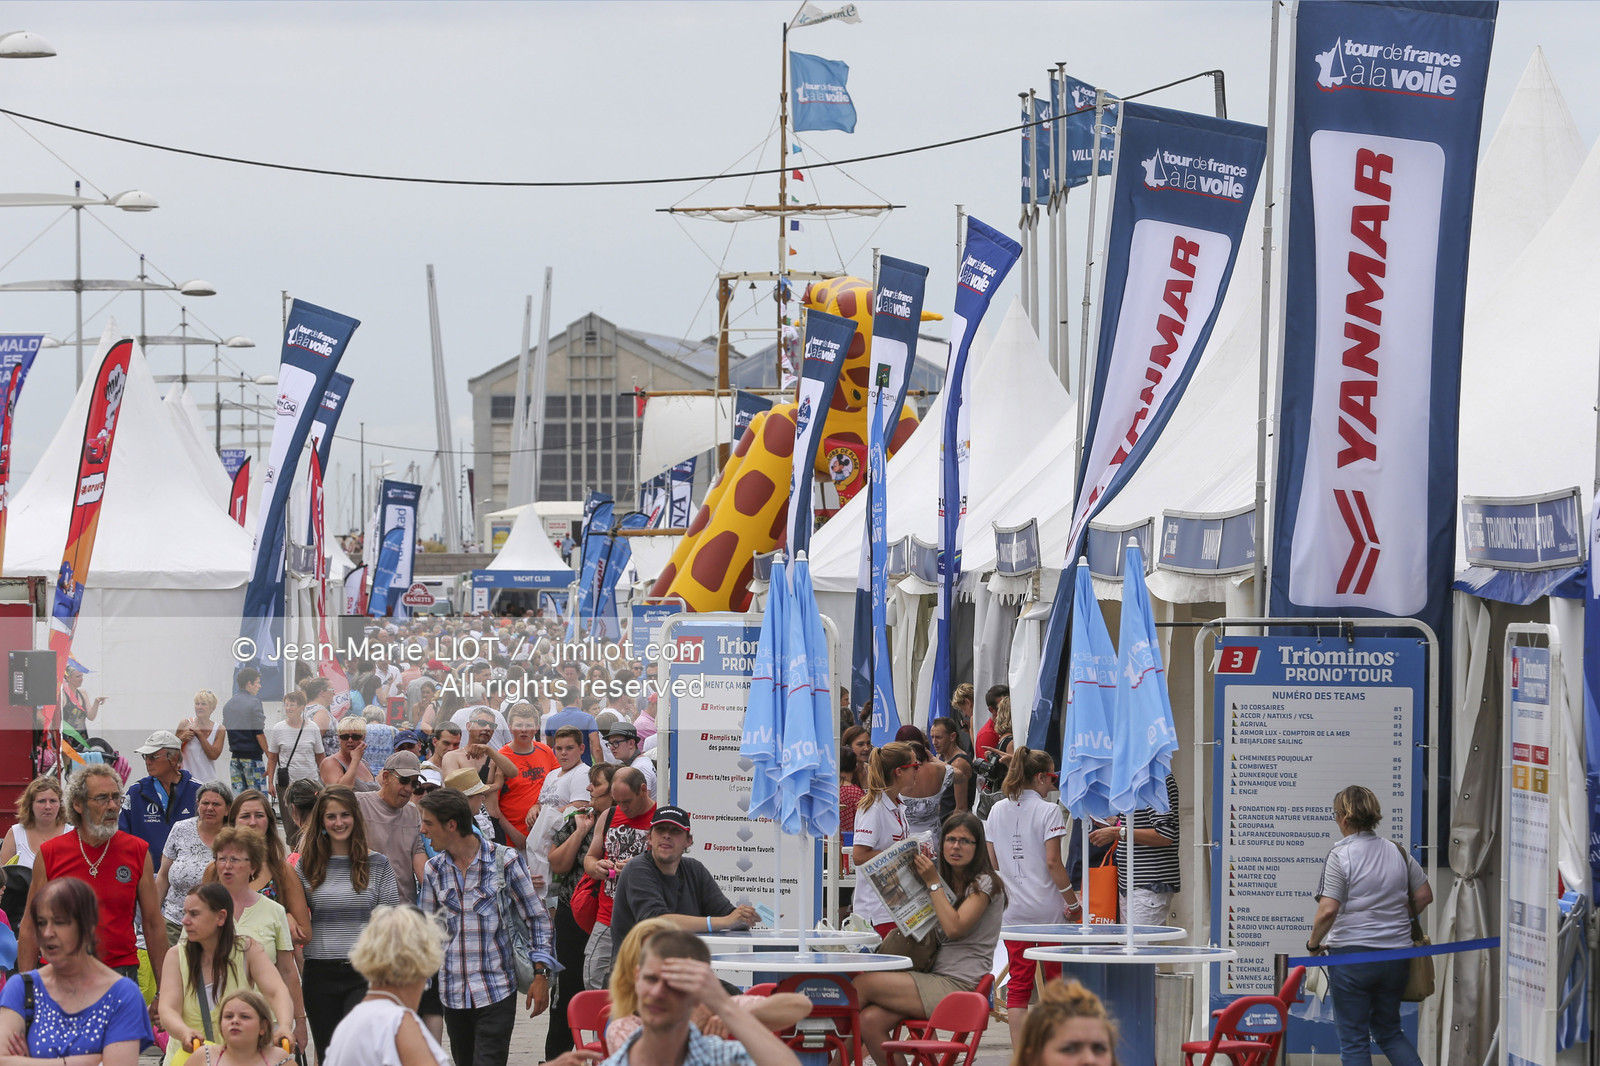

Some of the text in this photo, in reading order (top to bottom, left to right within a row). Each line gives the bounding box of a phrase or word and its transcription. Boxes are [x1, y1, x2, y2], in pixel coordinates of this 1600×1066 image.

[1350, 58, 1456, 95] à la voile
[825, 91, 849, 102] voile
[1200, 174, 1244, 199] voile
[970, 273, 990, 292] voile
[894, 302, 910, 318] voile
[1337, 147, 1394, 469] YANMAR
[308, 339, 332, 356] voile
[821, 349, 836, 362] voile
[848, 451, 859, 470] PLAGE
[1231, 651, 1244, 668] 3
[725, 682, 734, 691] ÇA
[1272, 690, 1365, 700] NUMÉRO DES TEAMS
[713, 844, 736, 852] Supporte
[865, 840, 918, 874] LA VOIX DU NORD
[730, 874, 745, 882] grilles
